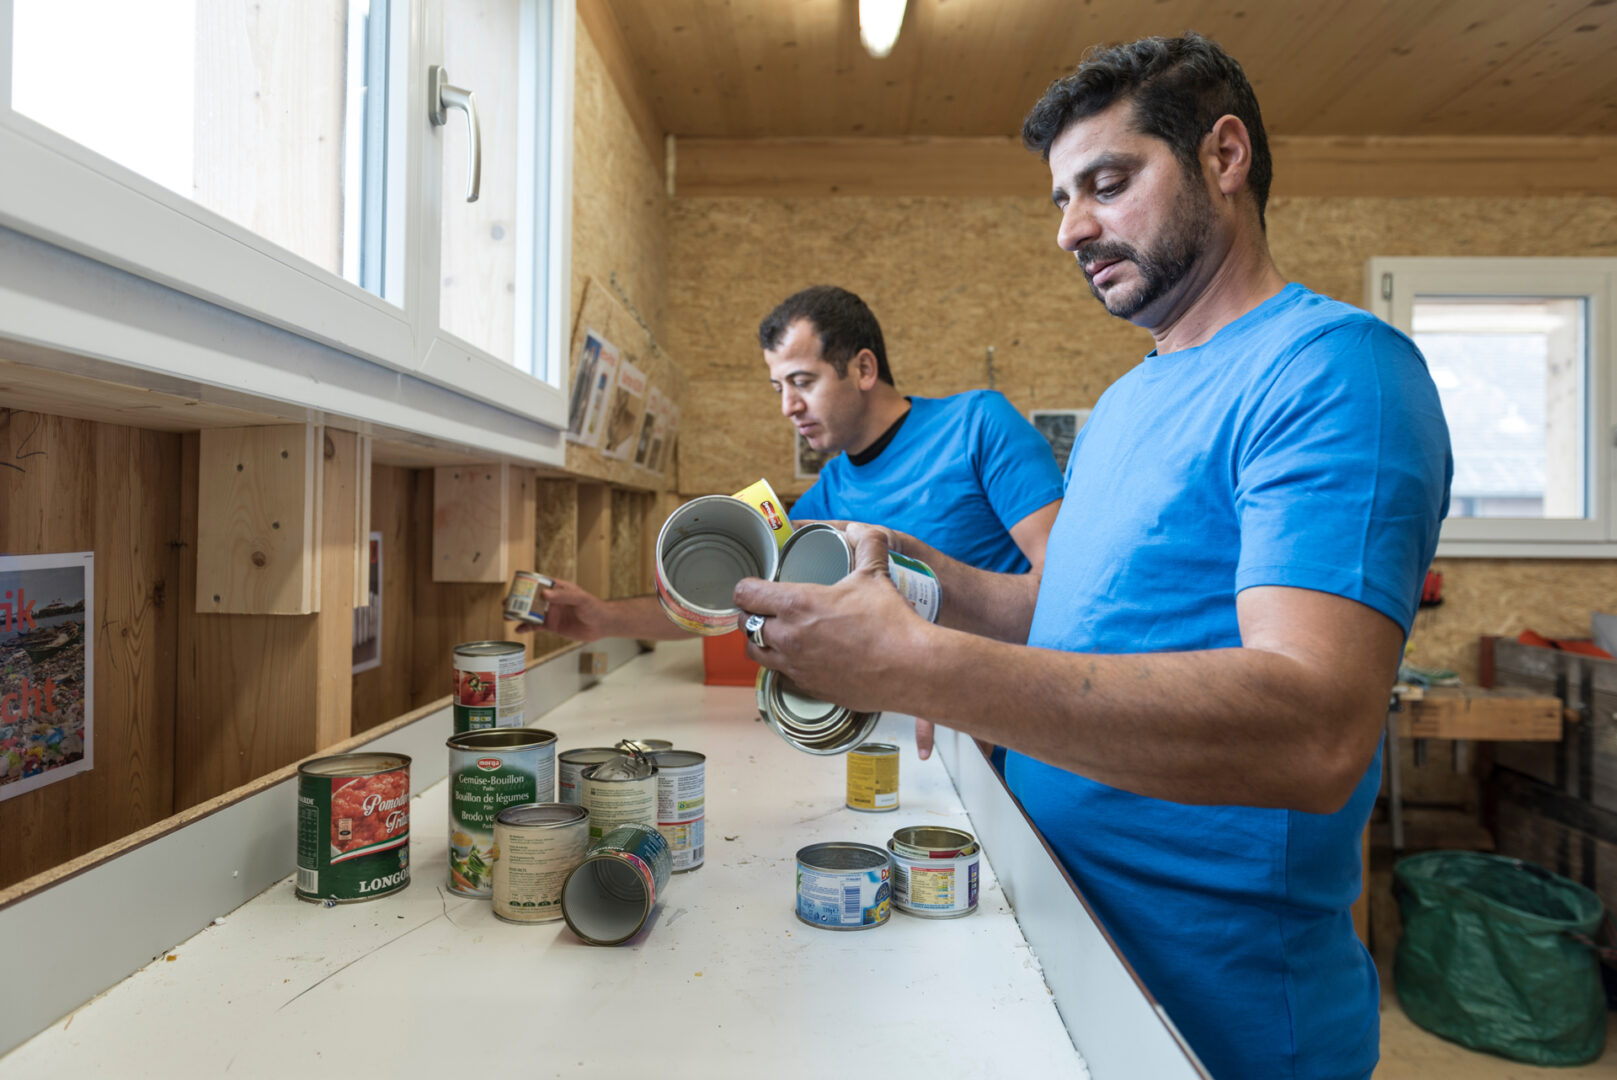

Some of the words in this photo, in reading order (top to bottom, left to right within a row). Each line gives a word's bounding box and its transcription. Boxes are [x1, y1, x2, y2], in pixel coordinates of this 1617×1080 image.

[1, 677, 56, 723] cht
[458, 773, 524, 785] Gemüse-Bouillon
[455, 791, 482, 803] Bouillon
[483, 793, 494, 803] de
[496, 792, 529, 805] légumes
[461, 811, 483, 822] Brodo
